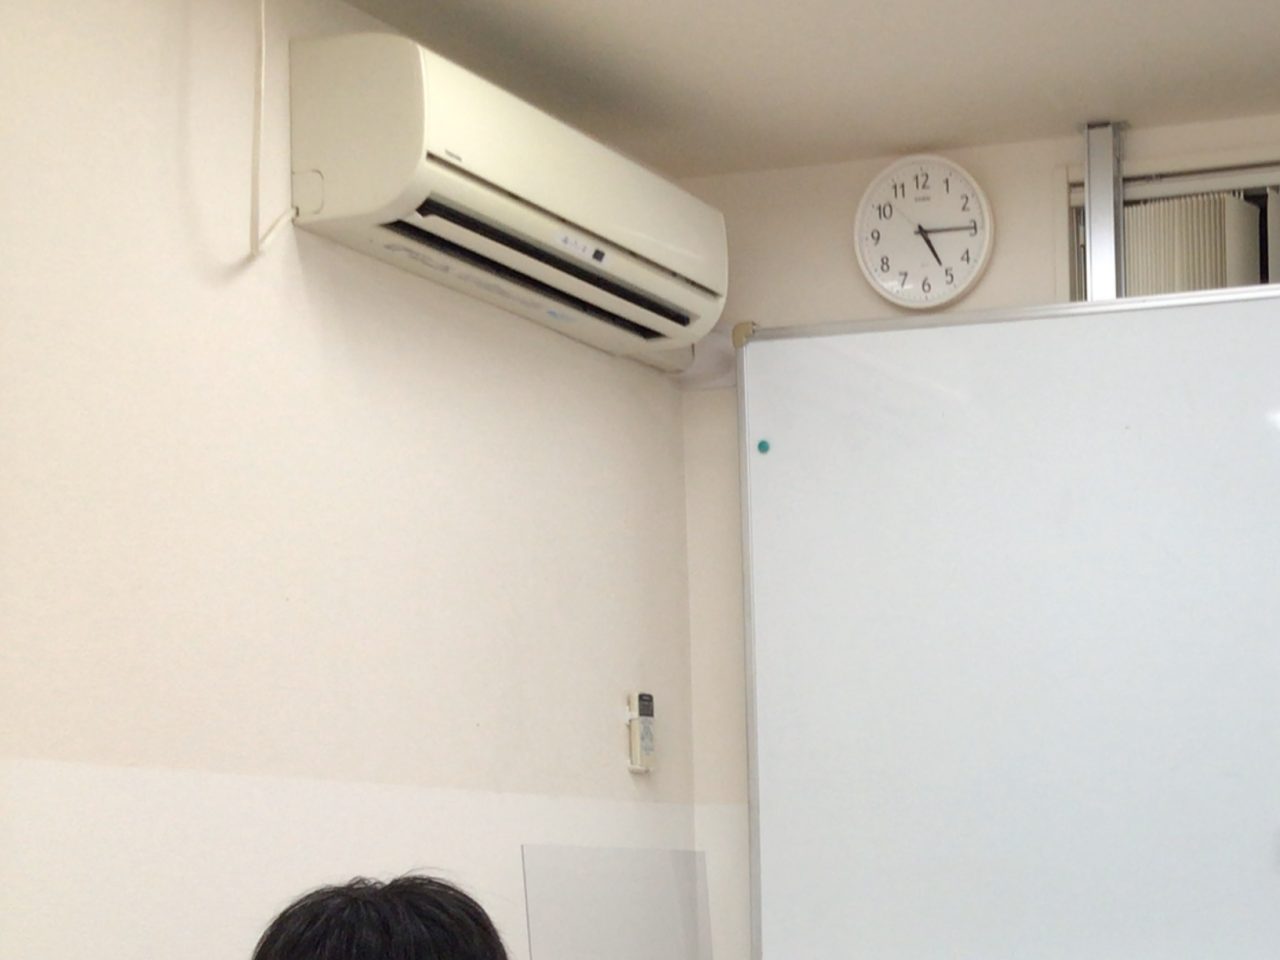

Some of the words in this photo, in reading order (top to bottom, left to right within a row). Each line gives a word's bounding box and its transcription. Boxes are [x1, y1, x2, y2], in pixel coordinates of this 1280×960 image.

[914, 173, 931, 190] 12
[943, 178, 950, 194] 1
[893, 183, 906, 199] 11
[877, 202, 893, 220] 10
[961, 194, 970, 212] 2
[870, 229, 881, 247] 9
[880, 256, 890, 273] 8
[960, 248, 970, 265] 4
[898, 272, 909, 288] 7
[944, 267, 954, 285] 5
[922, 277, 931, 293] 6
